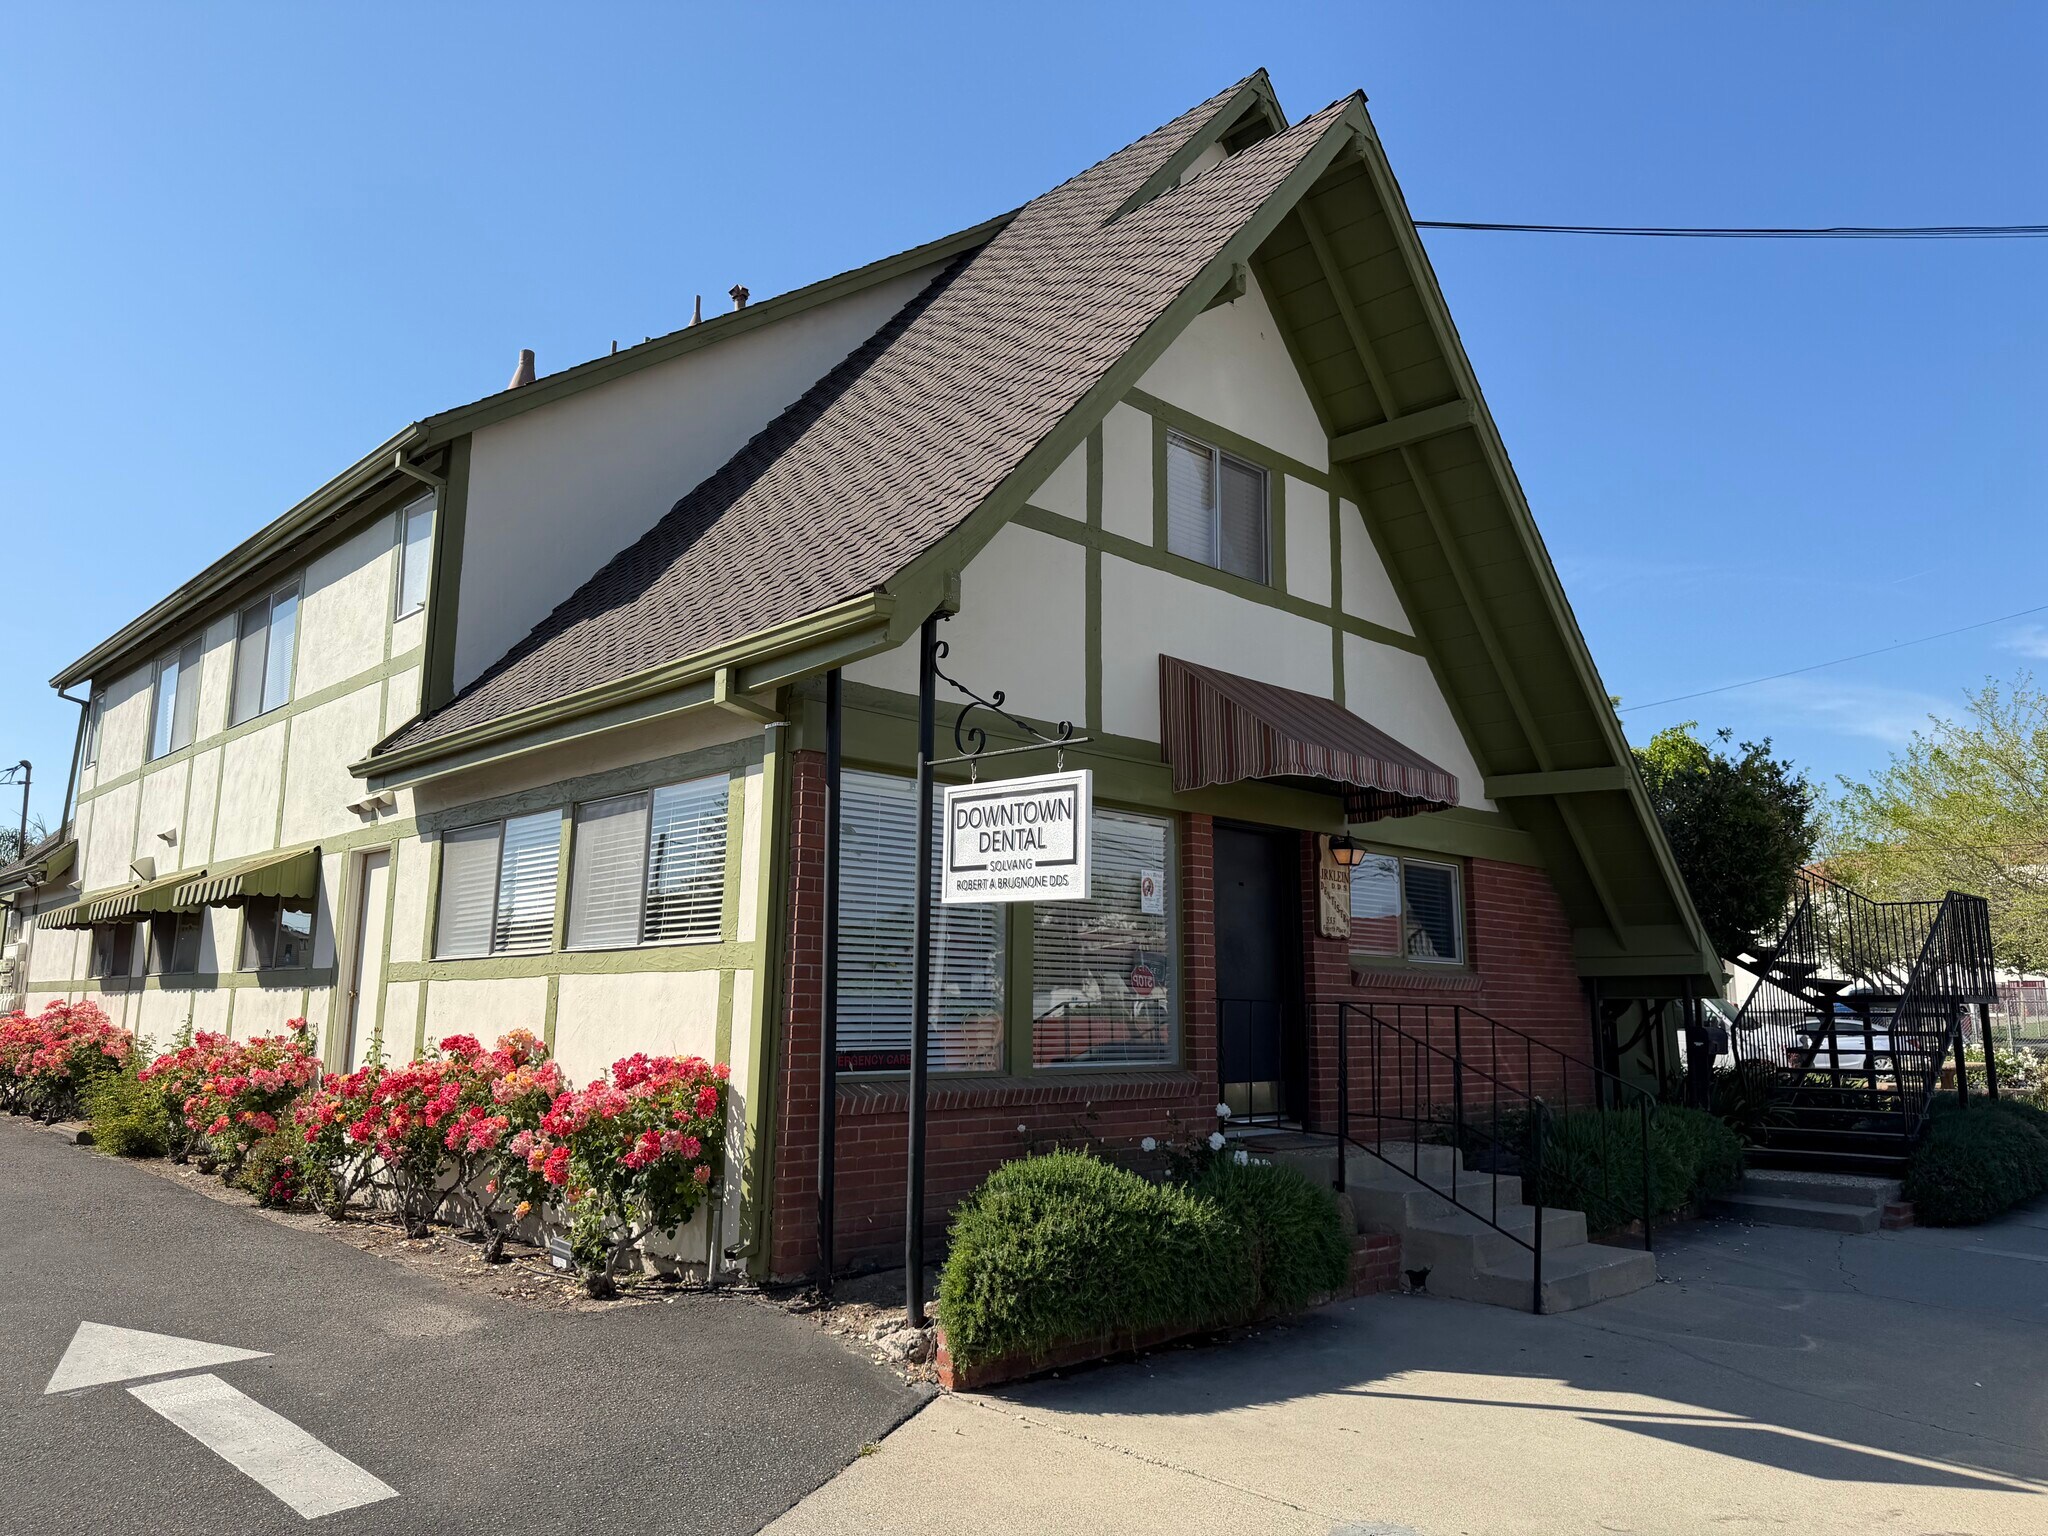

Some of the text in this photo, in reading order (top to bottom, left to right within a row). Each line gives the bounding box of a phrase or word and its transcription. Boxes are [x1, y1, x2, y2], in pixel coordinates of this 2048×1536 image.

[957, 797, 1071, 830] DOWNTOWN
[979, 827, 1047, 853] DENTAL
[990, 858, 1033, 872] SOLVANG
[956, 874, 1069, 891] ROBERT A BRUGNONE DDS
[837, 1054, 911, 1067] ERGENCY CARE
